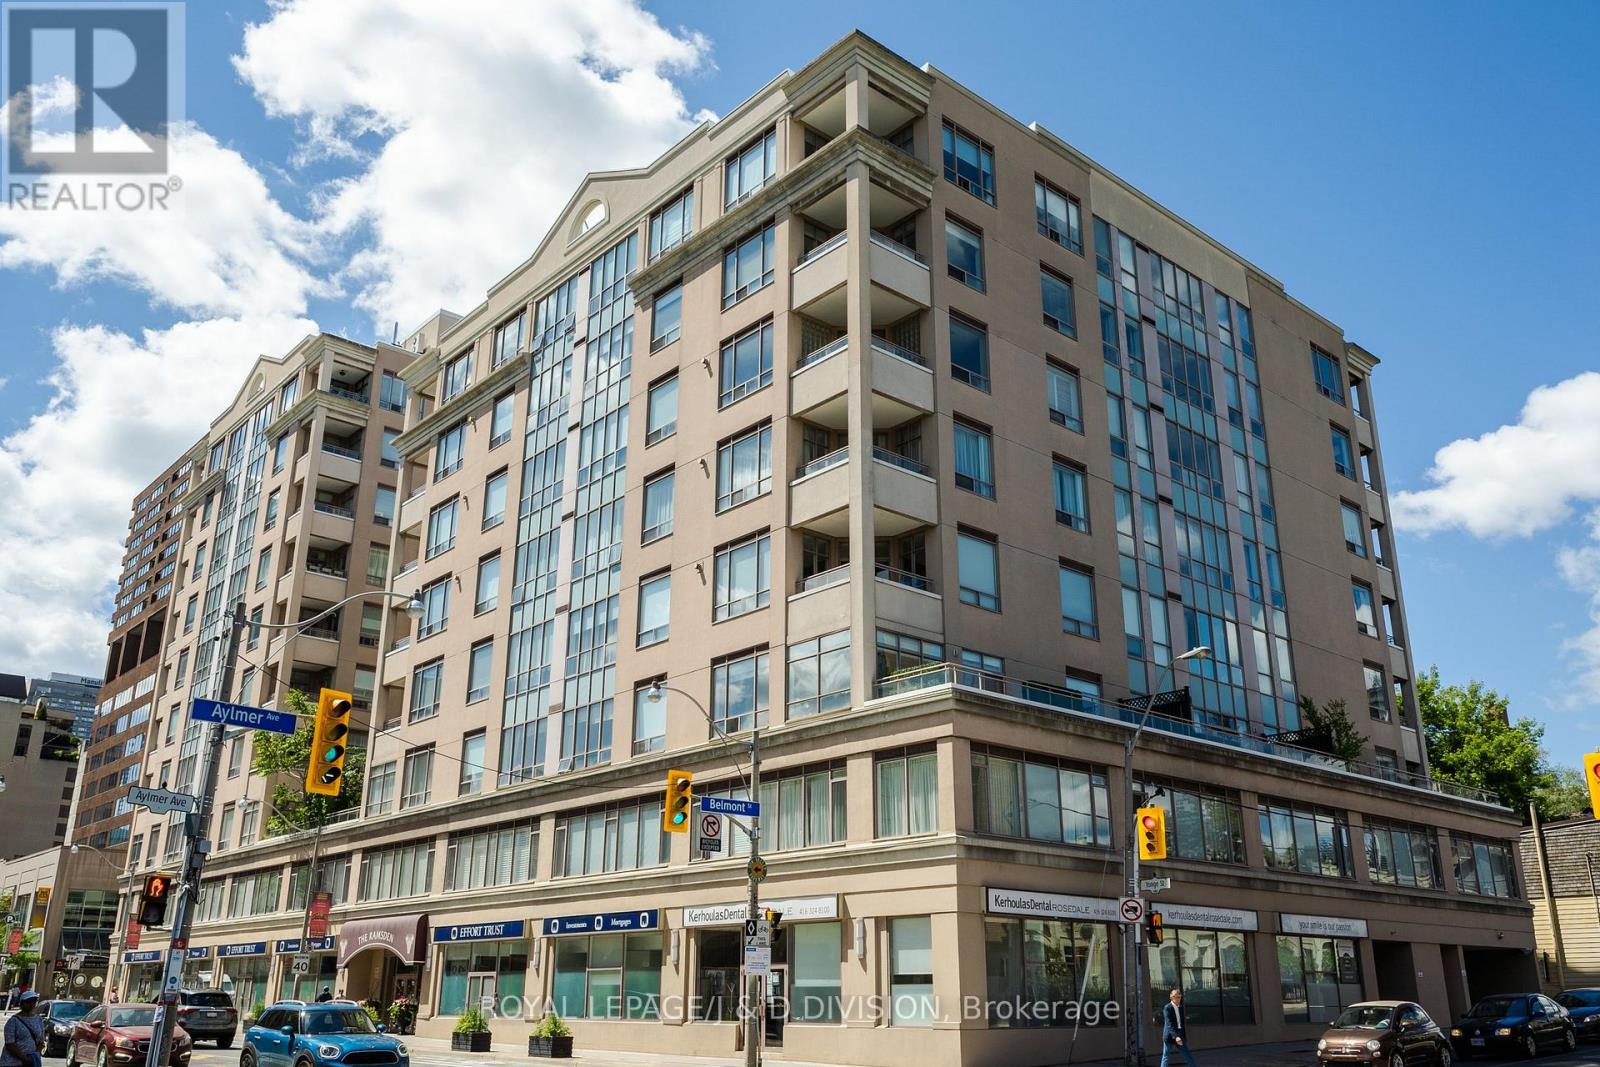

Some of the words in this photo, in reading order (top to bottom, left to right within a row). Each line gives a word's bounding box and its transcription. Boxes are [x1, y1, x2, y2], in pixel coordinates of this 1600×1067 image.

[211, 704, 264, 725] Aylmer
[266, 713, 280, 721] Ave
[135, 790, 168, 804] Aylmer
[170, 795, 187, 807] Ave
[709, 799, 746, 812] Belmont
[688, 907, 747, 922] KerhoulasDental
[358, 936, 367, 945] THE
[369, 930, 394, 943] RAMSDEN
[460, 926, 482, 938] EFFORT
[483, 924, 505, 936] TRUST
[293, 962, 308, 972] 40
